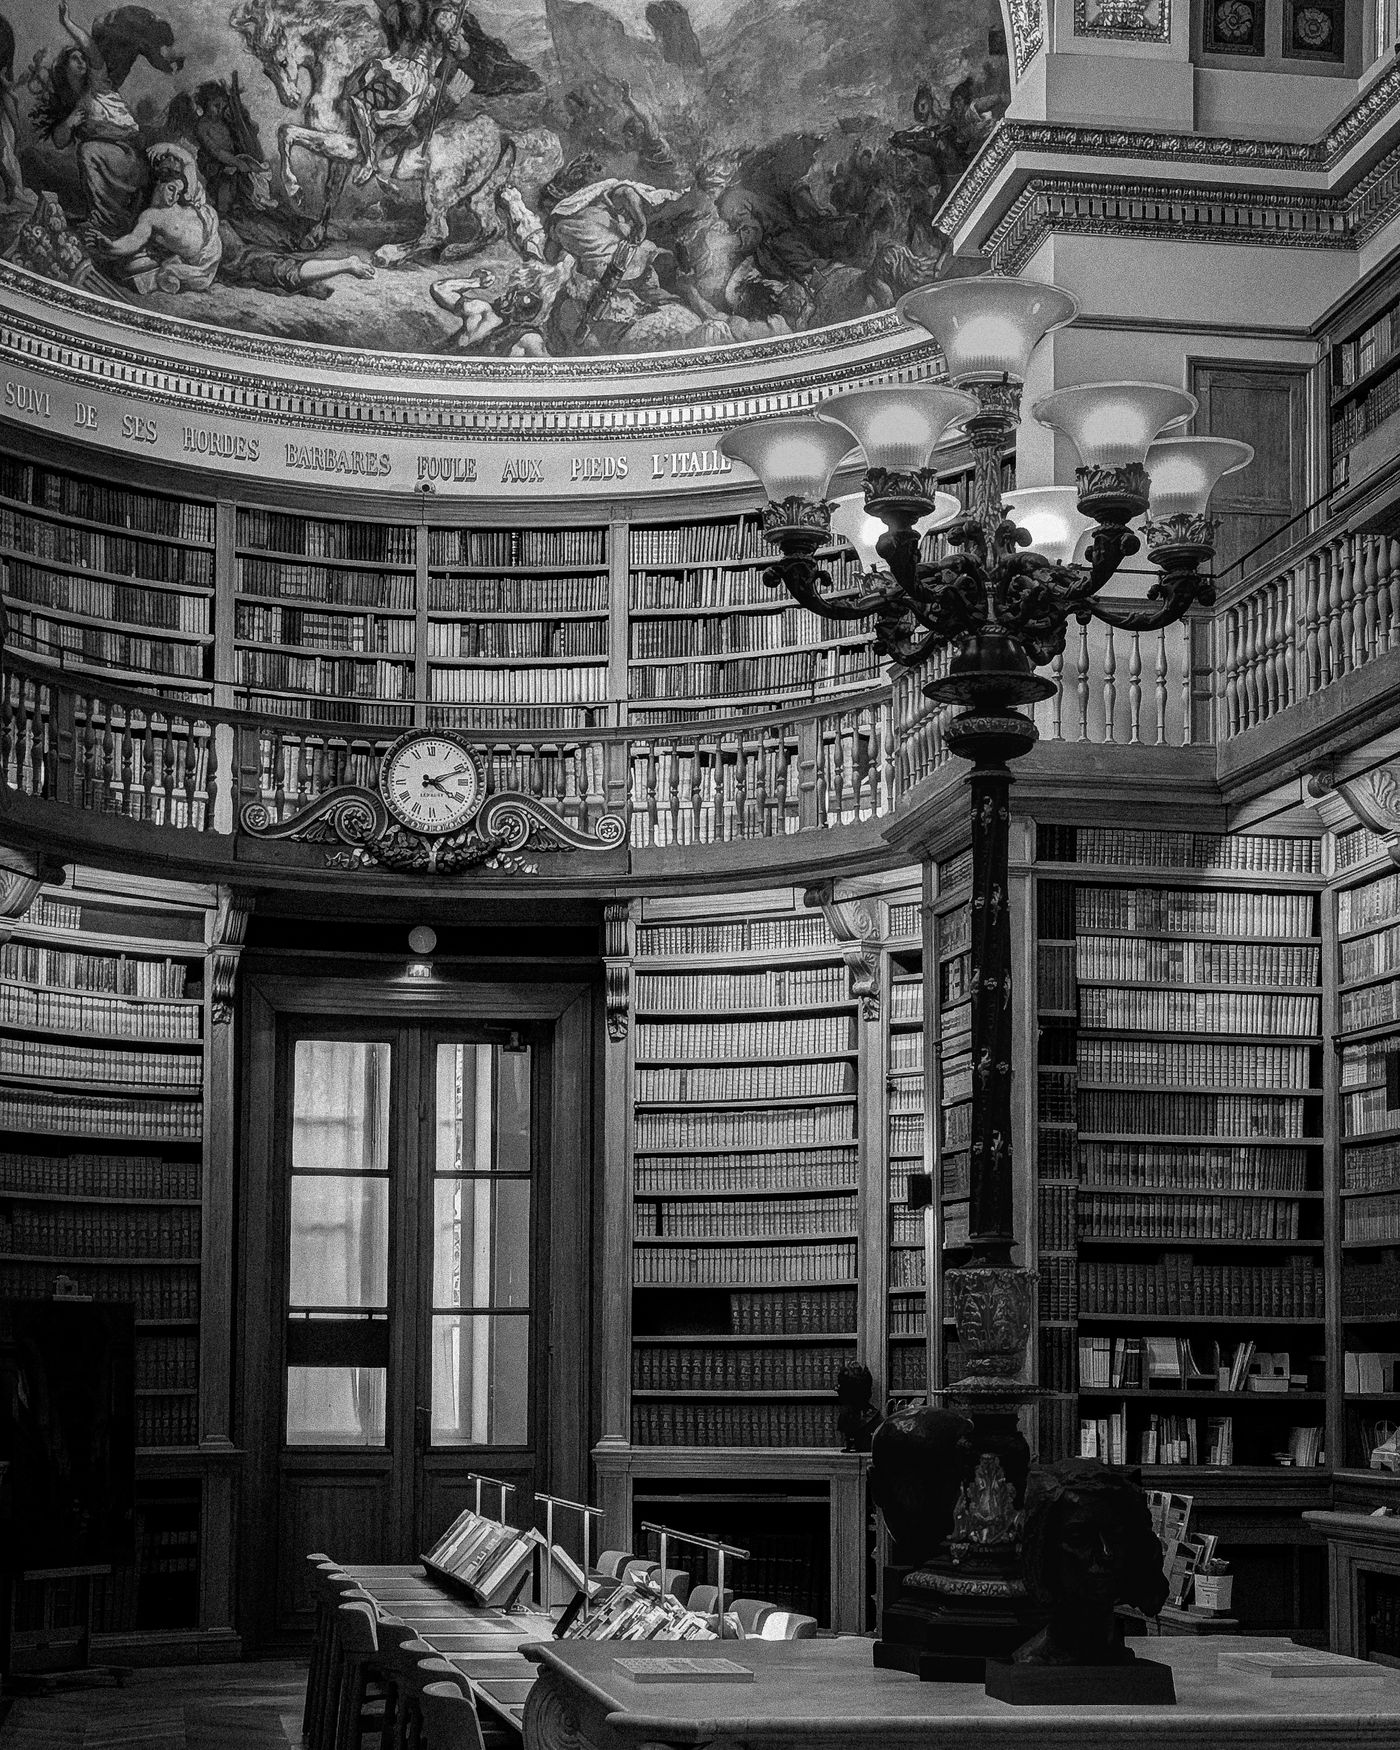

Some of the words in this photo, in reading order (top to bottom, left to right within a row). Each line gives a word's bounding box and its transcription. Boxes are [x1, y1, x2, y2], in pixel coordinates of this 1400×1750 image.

[5, 381, 51, 418] SUIVI
[74, 401, 98, 430] DE
[121, 414, 158, 444] SES
[182, 426, 261, 462] HORDES
[285, 442, 392, 477] BARBARES
[417, 455, 477, 482] FOULE
[501, 458, 545, 483] AUX
[570, 455, 629, 482] PIEDS
